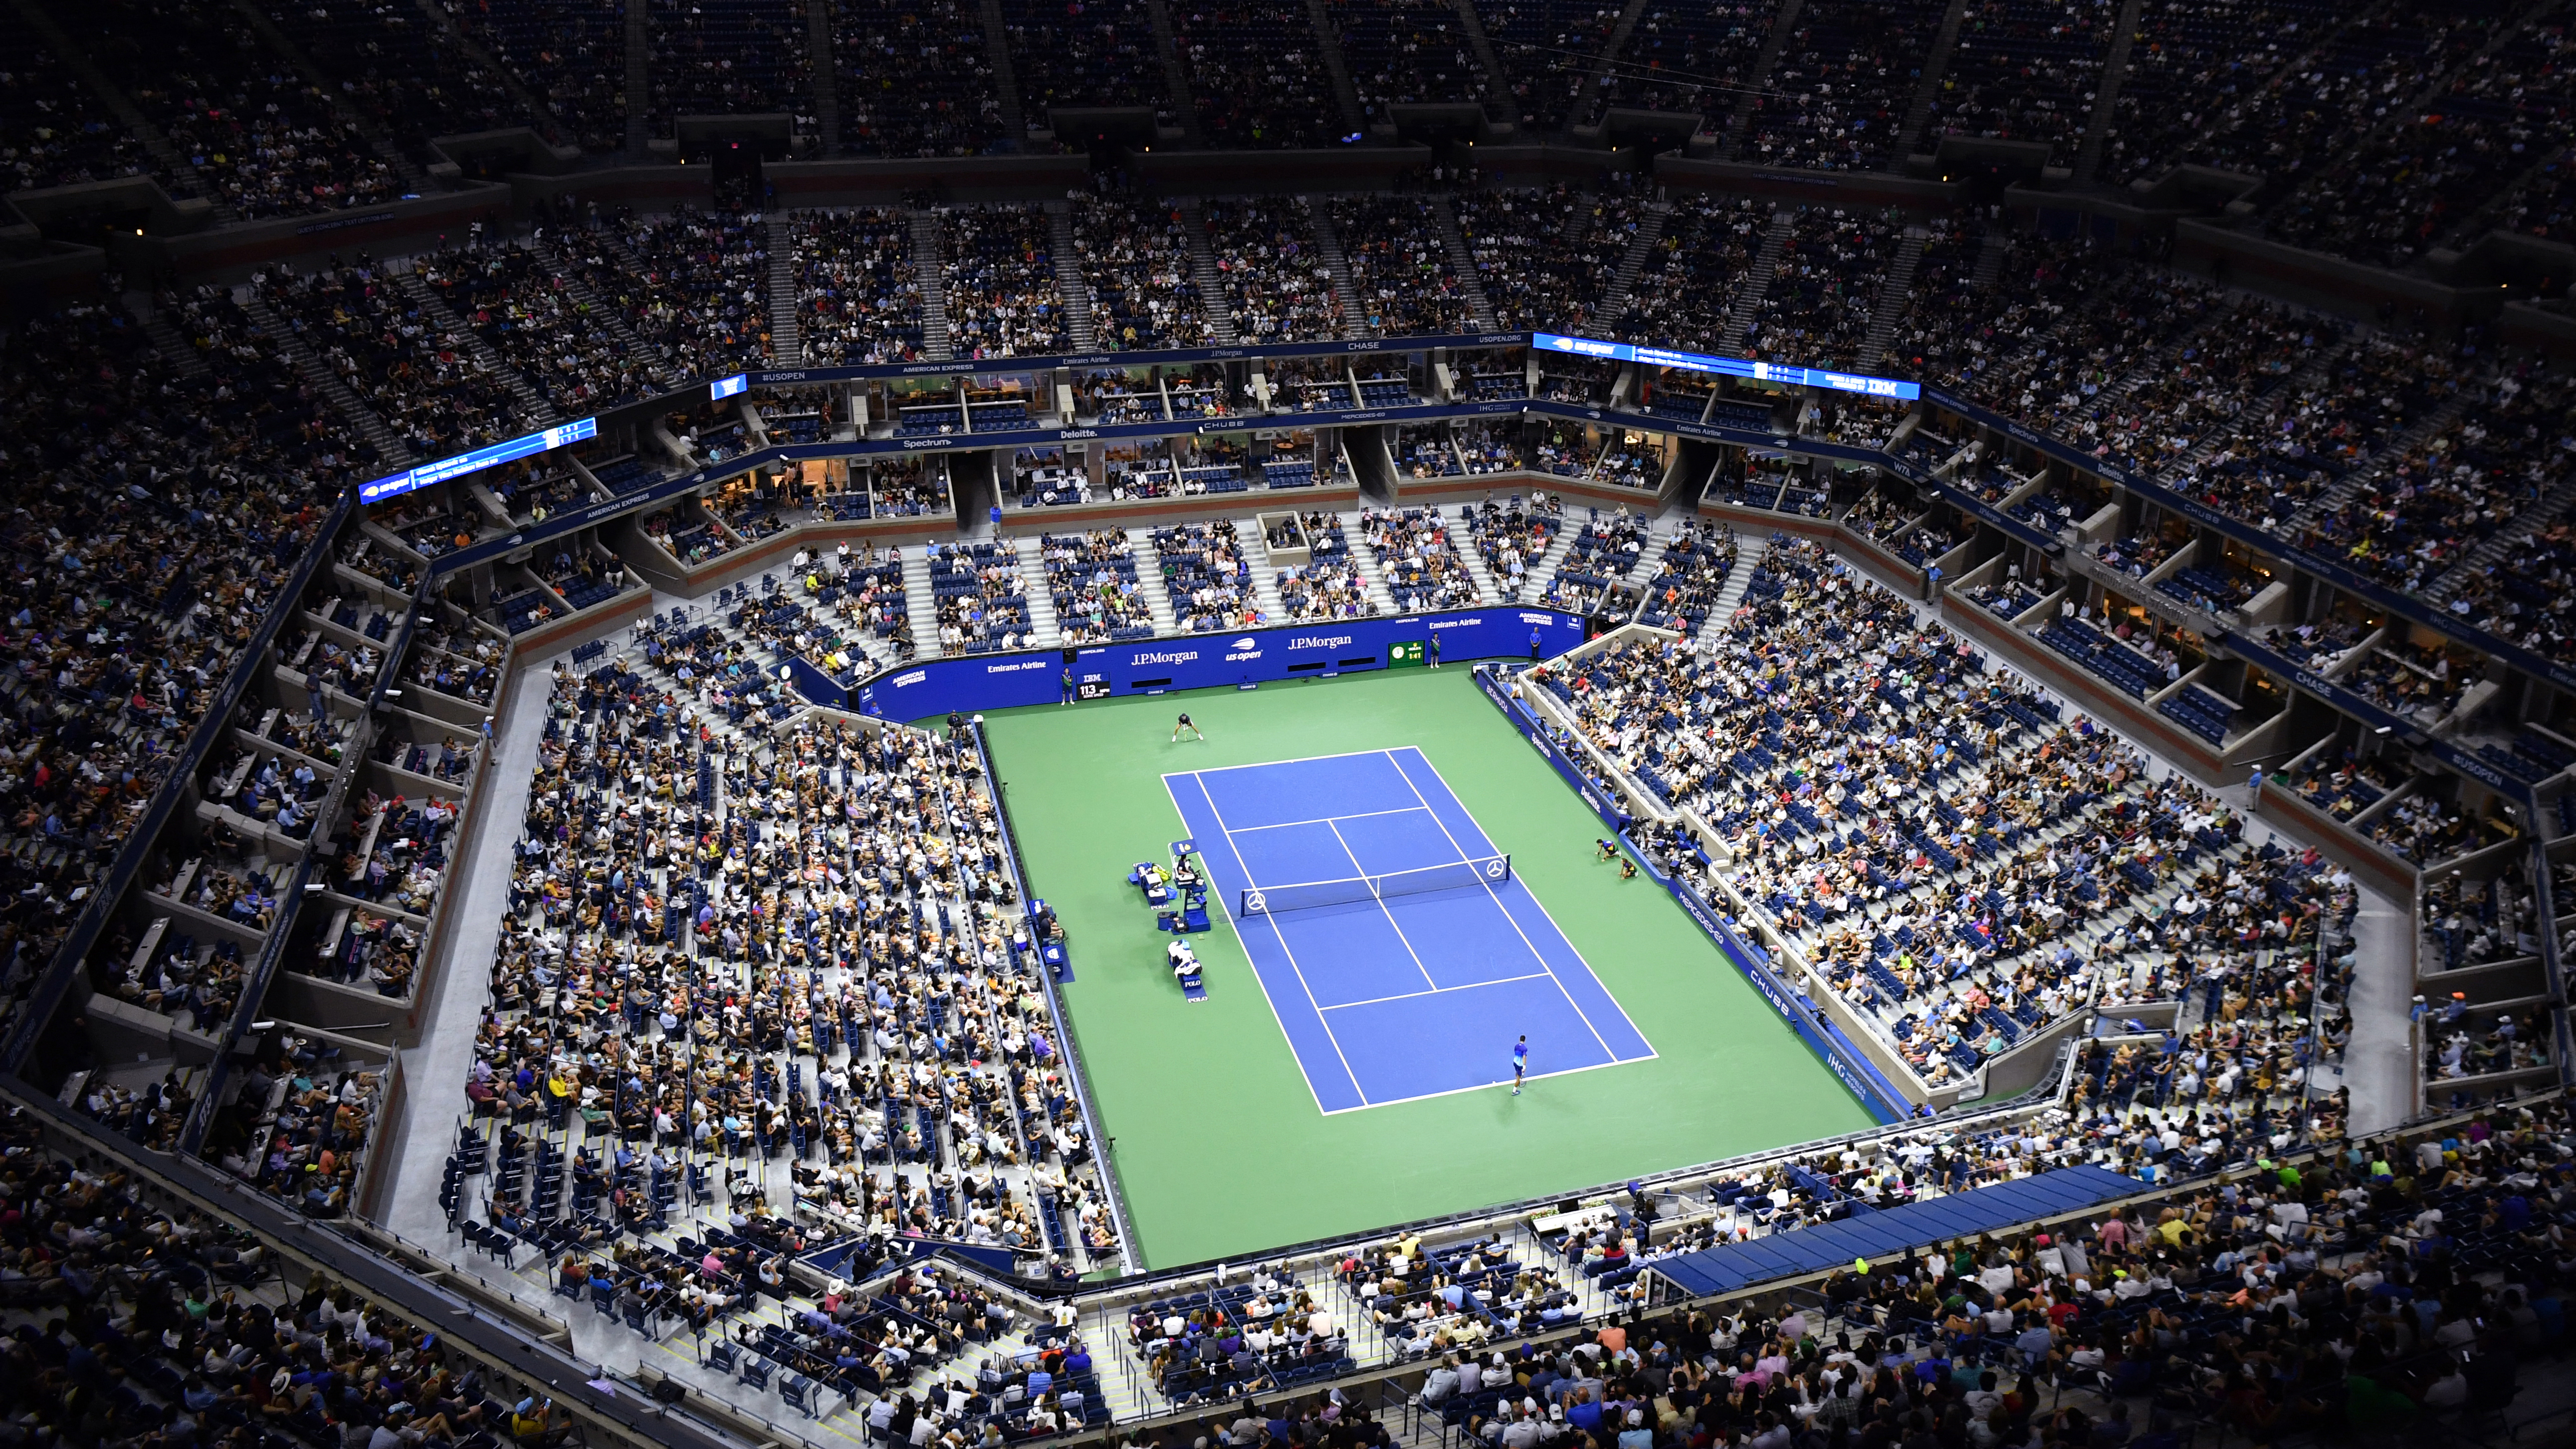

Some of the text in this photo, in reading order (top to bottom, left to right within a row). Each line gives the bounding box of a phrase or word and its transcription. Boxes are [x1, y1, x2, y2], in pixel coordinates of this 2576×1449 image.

[762, 372, 805, 381] #USOPEN
[1867, 380, 1897, 396] IBM
[1928, 391, 1968, 412] AMERICAN EXPRESS
[1677, 424, 1721, 436] Emirates Airline
[2008, 424, 2037, 442] Spectrum
[903, 439, 948, 449] Spectrum
[1894, 461, 1910, 477] WTA
[587, 492, 649, 519] AMERICAN EXPRESS
[2184, 503, 2219, 524] CHUBB
[1288, 636, 1351, 649] J.P.Morgan
[1131, 651, 1198, 665] J.P.Morgan
[1238, 650, 1261, 661] open
[988, 661, 1046, 673] Emirates Airline
[893, 670, 925, 684] AMERICAN
[897, 675, 926, 688] EXPRESS
[1083, 674, 1101, 682] IBM
[2295, 672, 2331, 697] CHASE
[1080, 685, 1096, 694] 113
[1487, 685, 1508, 713] BERMUDA
[1532, 733, 1550, 758] Spectrum
[2453, 754, 2503, 787] #USOPEN
[1581, 786, 1600, 813] Deloitte.
[1679, 892, 1723, 944] MERCEDES-EQ
[1750, 970, 1789, 1016] CHUBB
[1828, 1052, 1845, 1077] IHG
[1845, 1077, 1865, 1100] RESORTS
[1846, 1071, 1863, 1091] HOTELS
